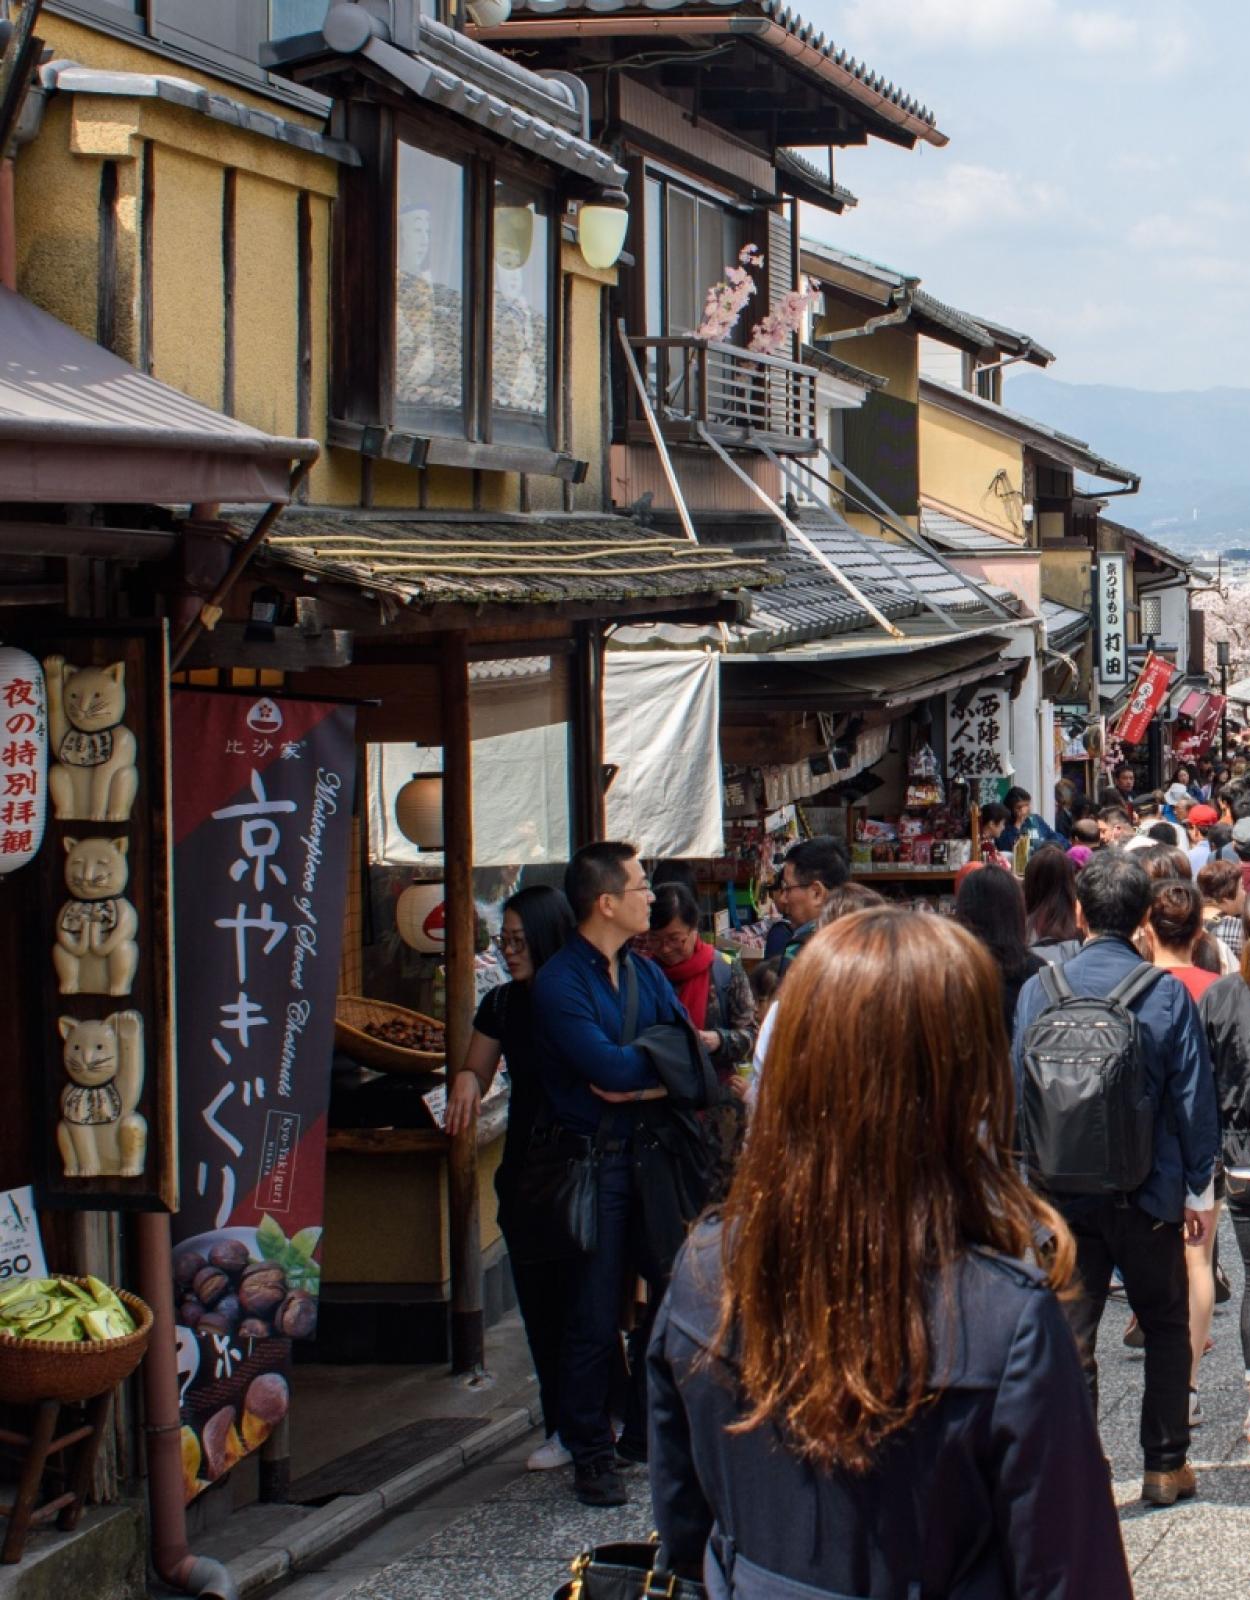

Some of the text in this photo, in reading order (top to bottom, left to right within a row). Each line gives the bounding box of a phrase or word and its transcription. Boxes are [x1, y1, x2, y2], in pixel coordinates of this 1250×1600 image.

[0, 678, 38, 854] 夜の特別拝観
[975, 693, 1004, 775] 西陣織
[198, 769, 298, 1229] 京やきぐり
[276, 767, 343, 1098] Masterpiece of Sweet Chestnuts
